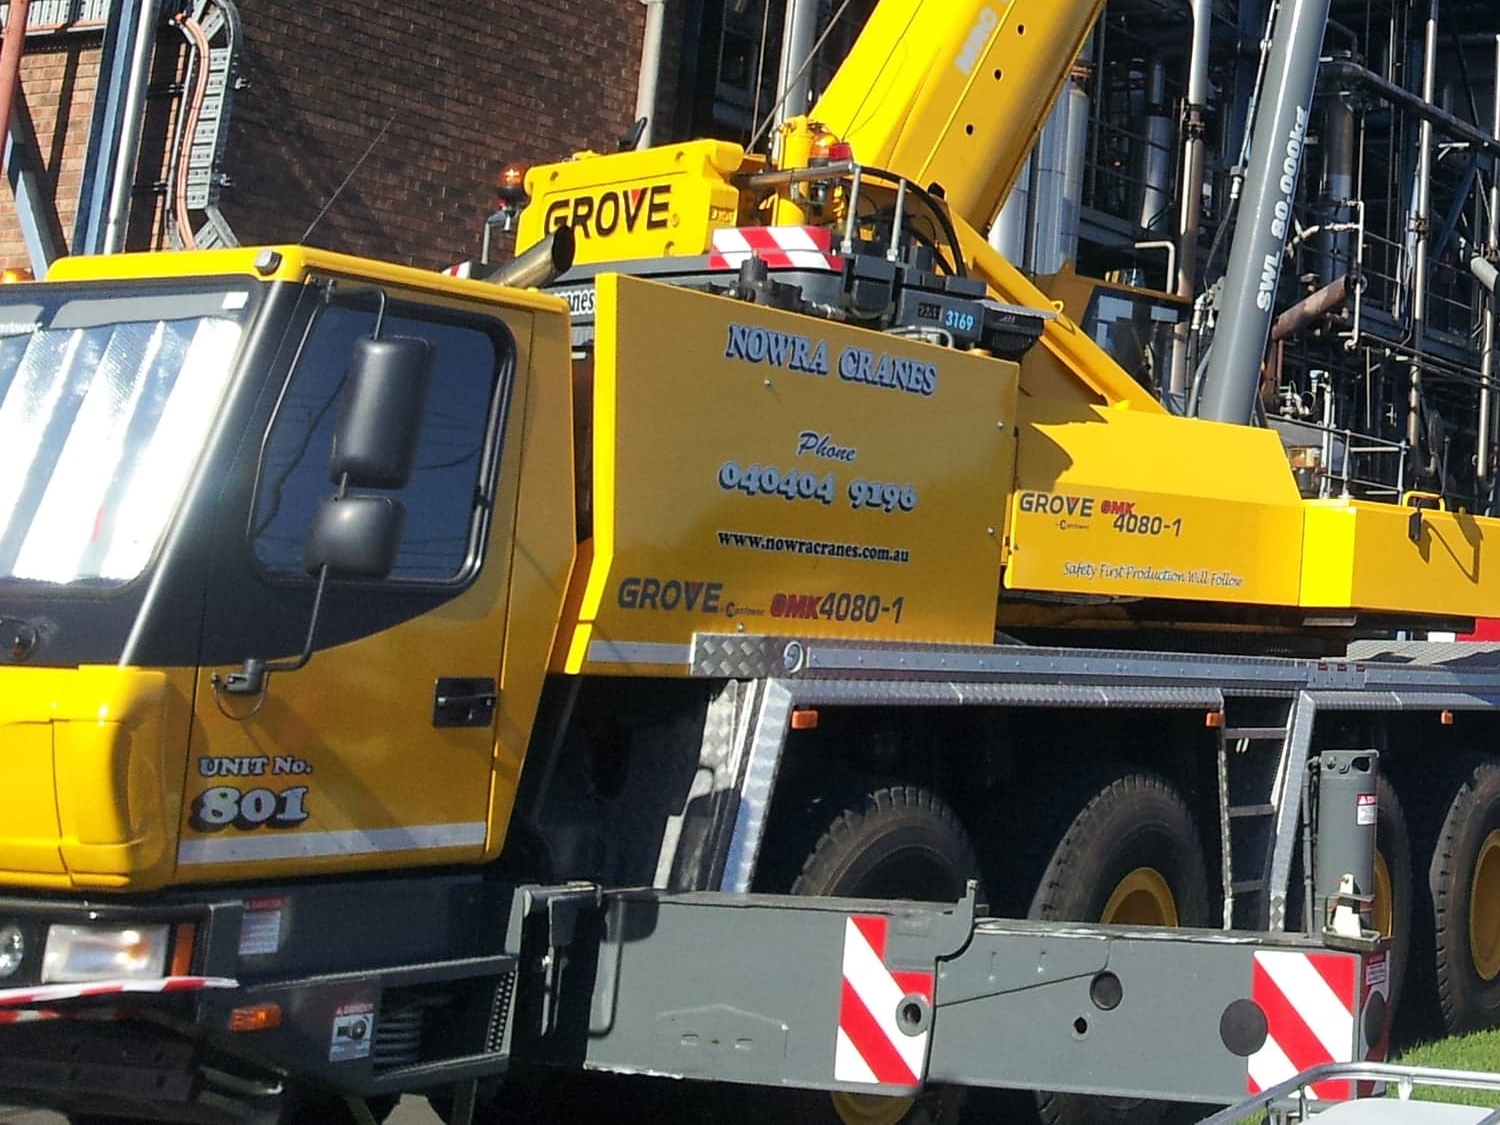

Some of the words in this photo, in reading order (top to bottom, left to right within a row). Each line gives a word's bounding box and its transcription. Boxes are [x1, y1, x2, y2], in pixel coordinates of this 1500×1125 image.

[544, 184, 672, 242] GROVE
[1257, 251, 1281, 312] SWL
[945, 309, 975, 332] 3169
[725, 323, 829, 376] NOWRA
[838, 346, 938, 396] CRANES
[798, 431, 857, 462] Phone
[718, 461, 837, 506] 040404
[849, 478, 919, 514] 9196
[1019, 491, 1095, 518] GROVE
[1100, 499, 1136, 516] GMK
[1113, 513, 1183, 538] 4080-1
[717, 530, 911, 563] www.nowracranes.com.au
[1063, 561, 1097, 580] Safety
[1100, 563, 1126, 579] First
[1126, 566, 1185, 584] Production
[1188, 570, 1208, 585] Will
[1210, 572, 1243, 587] Follow
[617, 577, 723, 613] GROVE
[199, 755, 268, 776] UNIT
[272, 755, 312, 775] No.
[196, 785, 309, 828] 801
